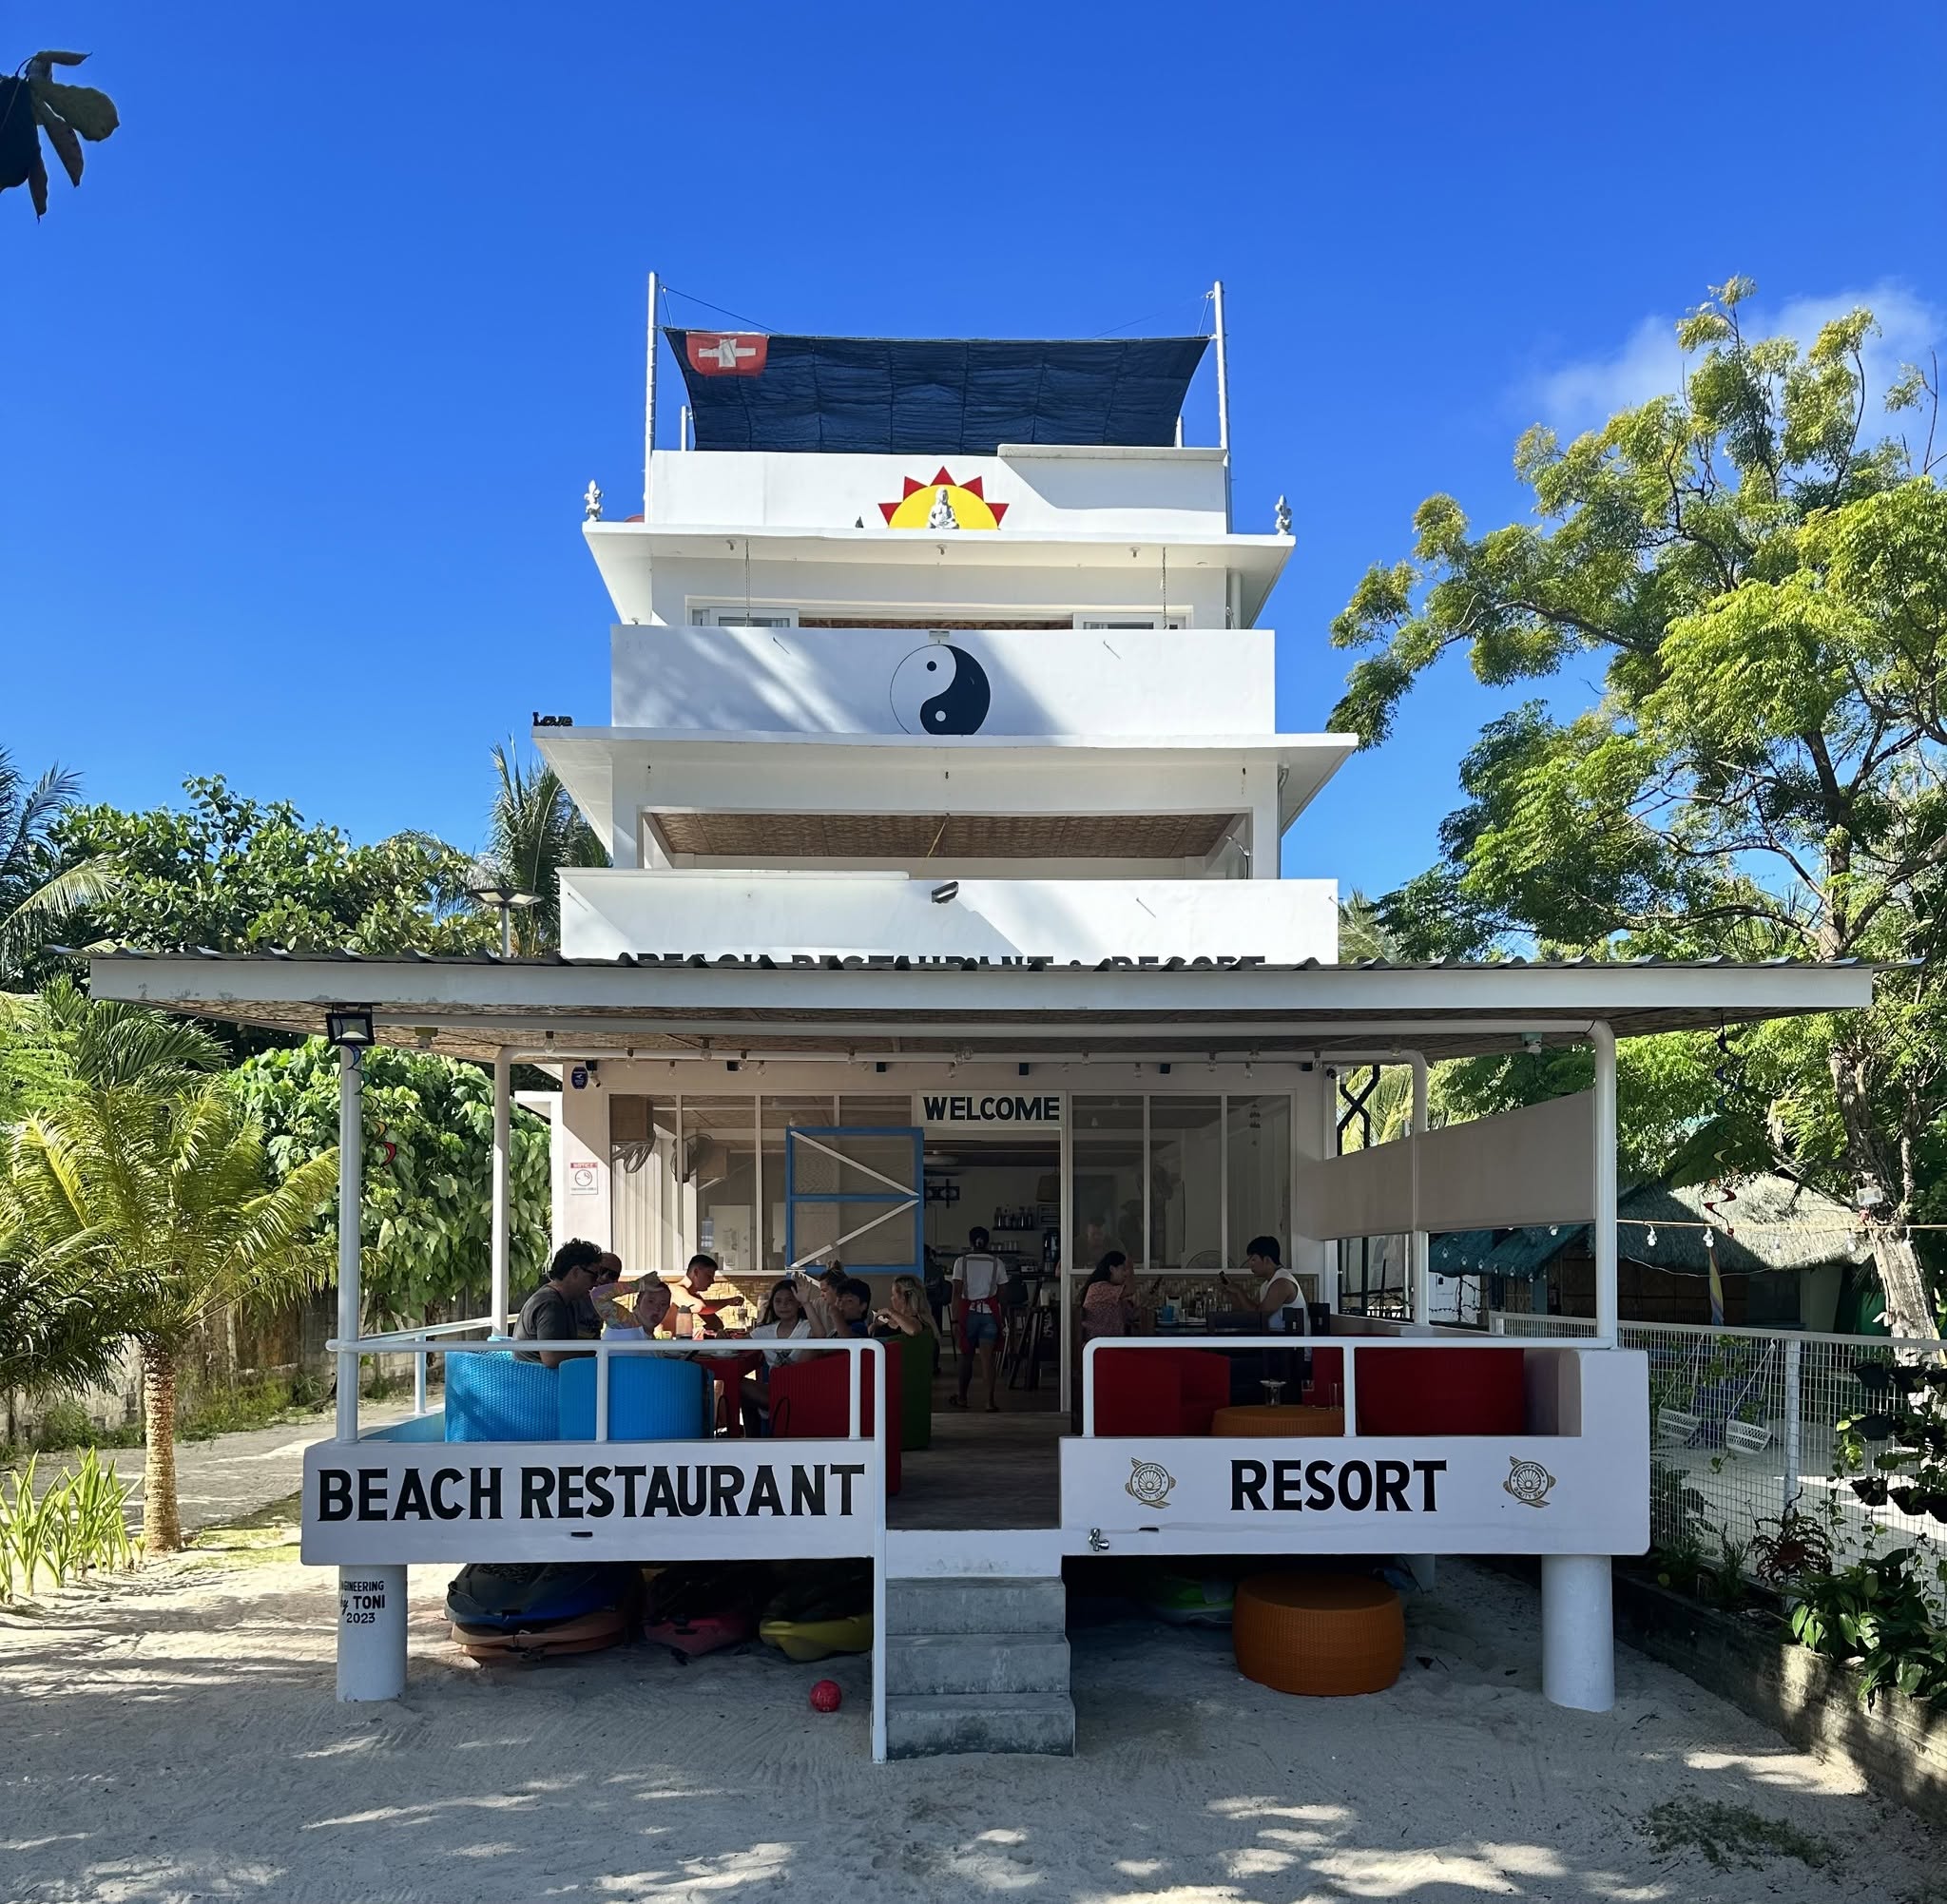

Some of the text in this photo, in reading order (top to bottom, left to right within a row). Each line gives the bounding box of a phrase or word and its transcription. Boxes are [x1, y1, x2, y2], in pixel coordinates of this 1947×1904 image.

[532, 711, 573, 726] Love
[922, 1096, 1060, 1121] WELCOME
[318, 1463, 865, 1522] BEACH RESTAURANT
[1229, 1458, 1447, 1512] RESORT
[353, 1594, 386, 1609] TONI
[346, 1612, 376, 1624] 2023
